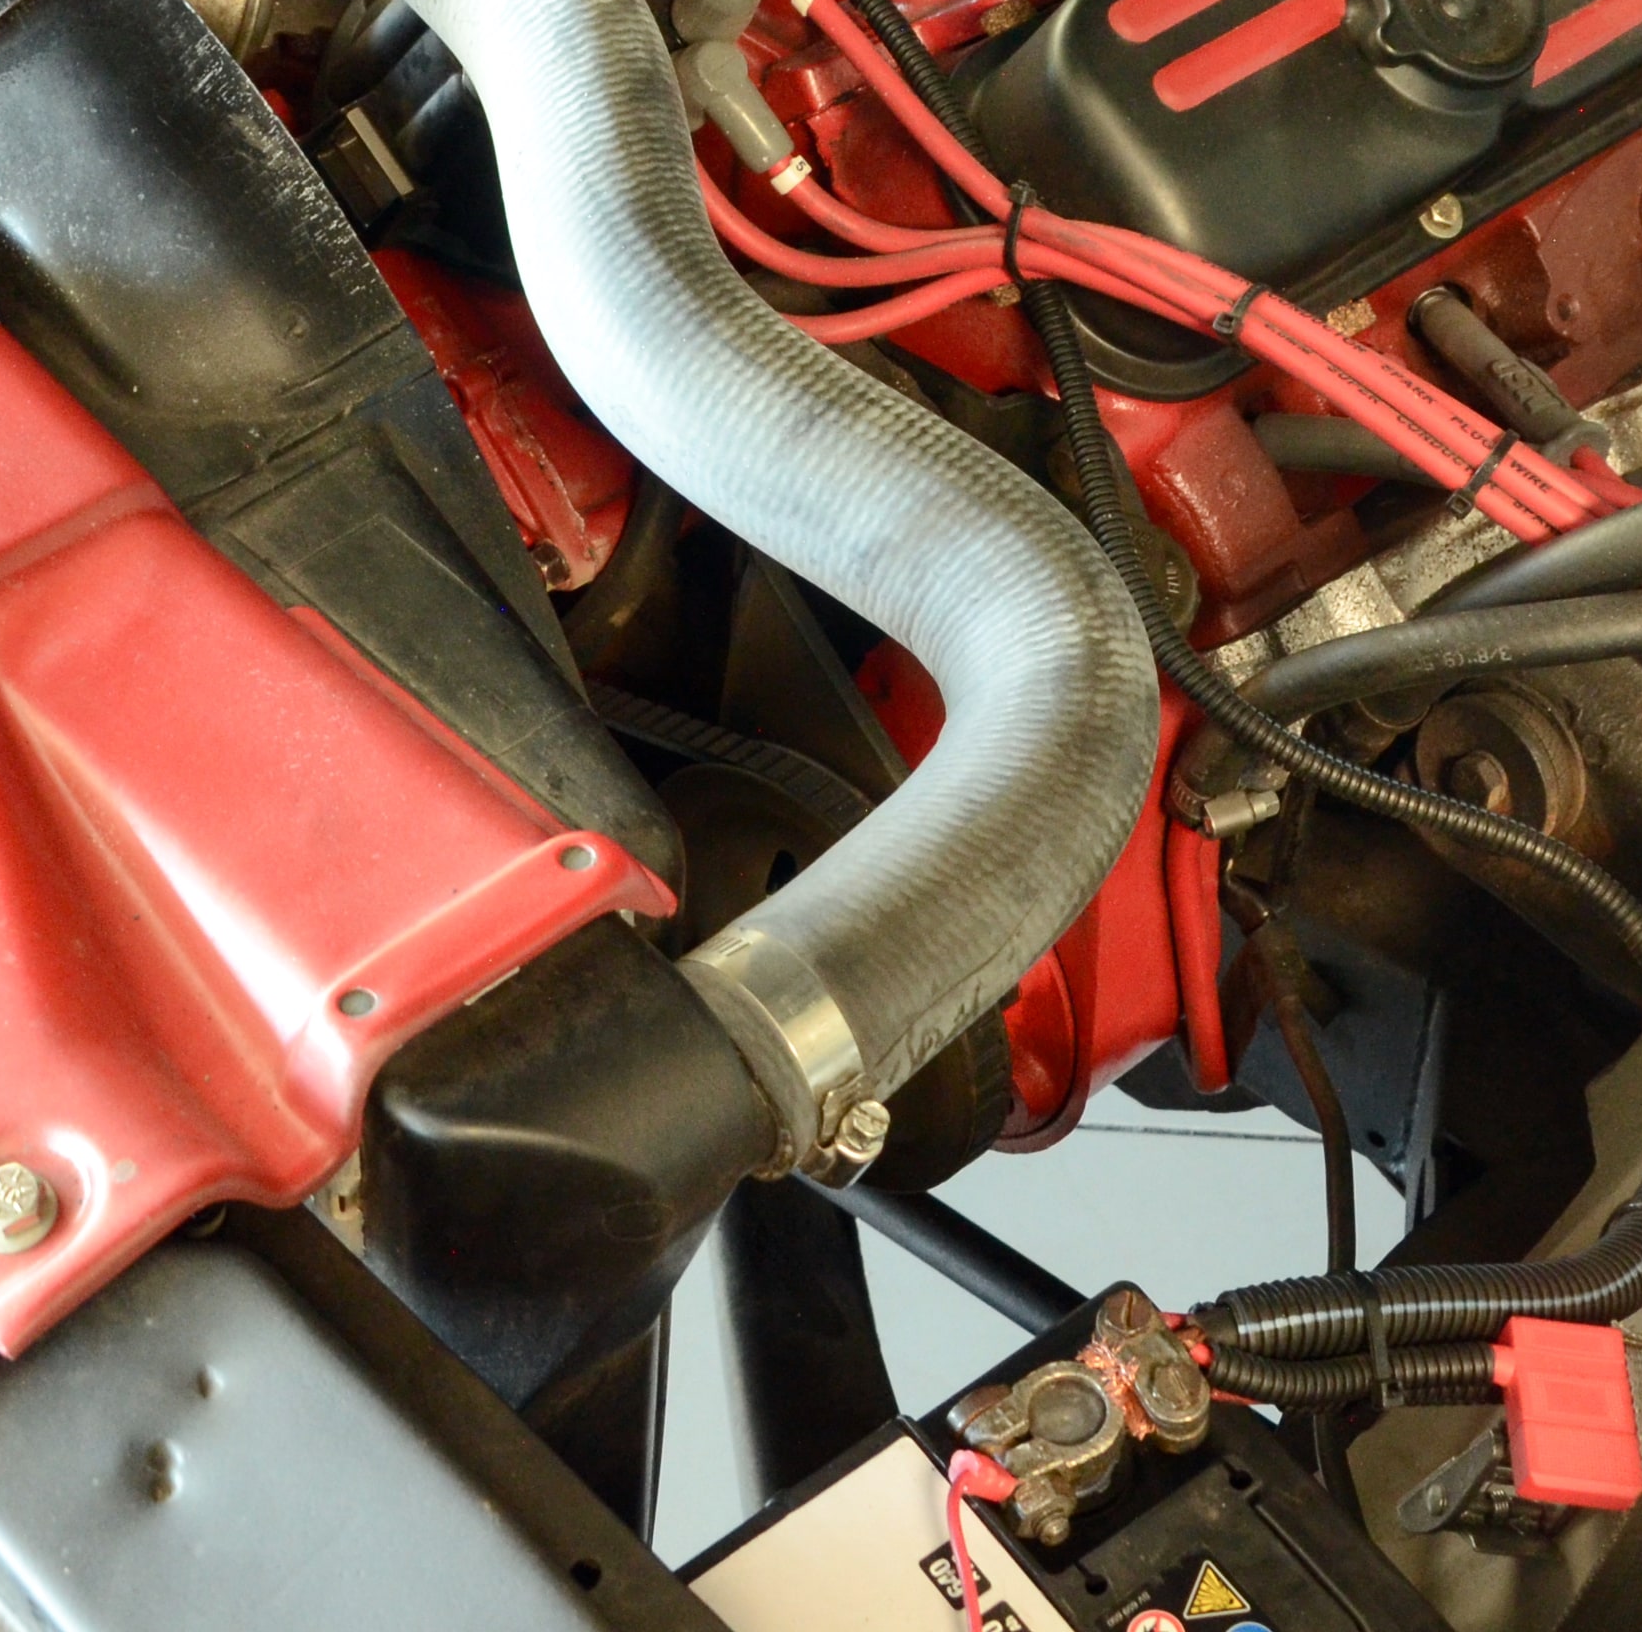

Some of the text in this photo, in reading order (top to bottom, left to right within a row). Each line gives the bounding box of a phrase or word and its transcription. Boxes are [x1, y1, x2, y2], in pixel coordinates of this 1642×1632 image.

[1381, 363, 1437, 406] SPARK
[1450, 414, 1497, 451] PLUG
[1508, 458, 1553, 495] WIRE
